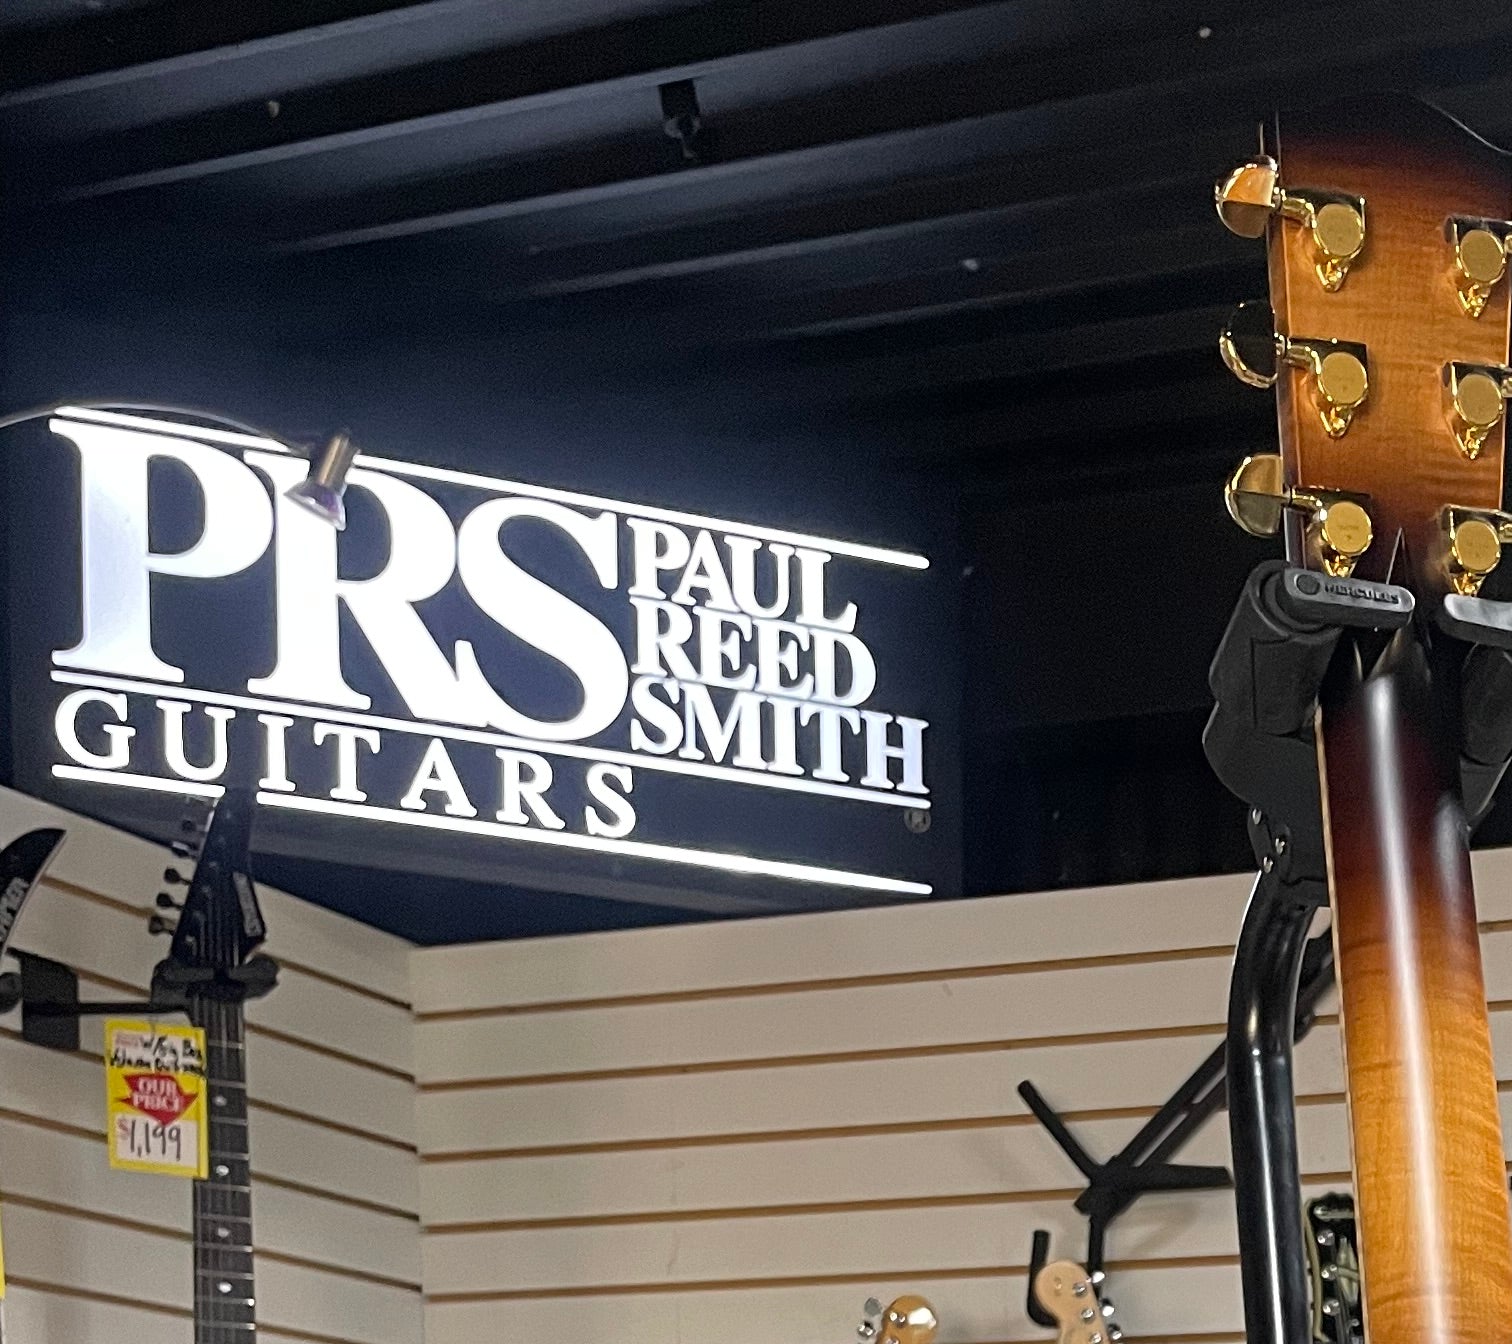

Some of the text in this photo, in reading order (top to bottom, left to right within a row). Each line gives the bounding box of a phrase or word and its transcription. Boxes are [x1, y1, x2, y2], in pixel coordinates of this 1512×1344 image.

[50, 418, 628, 742] PRS
[628, 516, 858, 633] PAUL
[629, 596, 877, 709] REED
[53, 687, 638, 840] GUITARS
[630, 676, 930, 795] SMITH
[132, 1093, 181, 1112] PRICE
[138, 1077, 177, 1096] OUR
